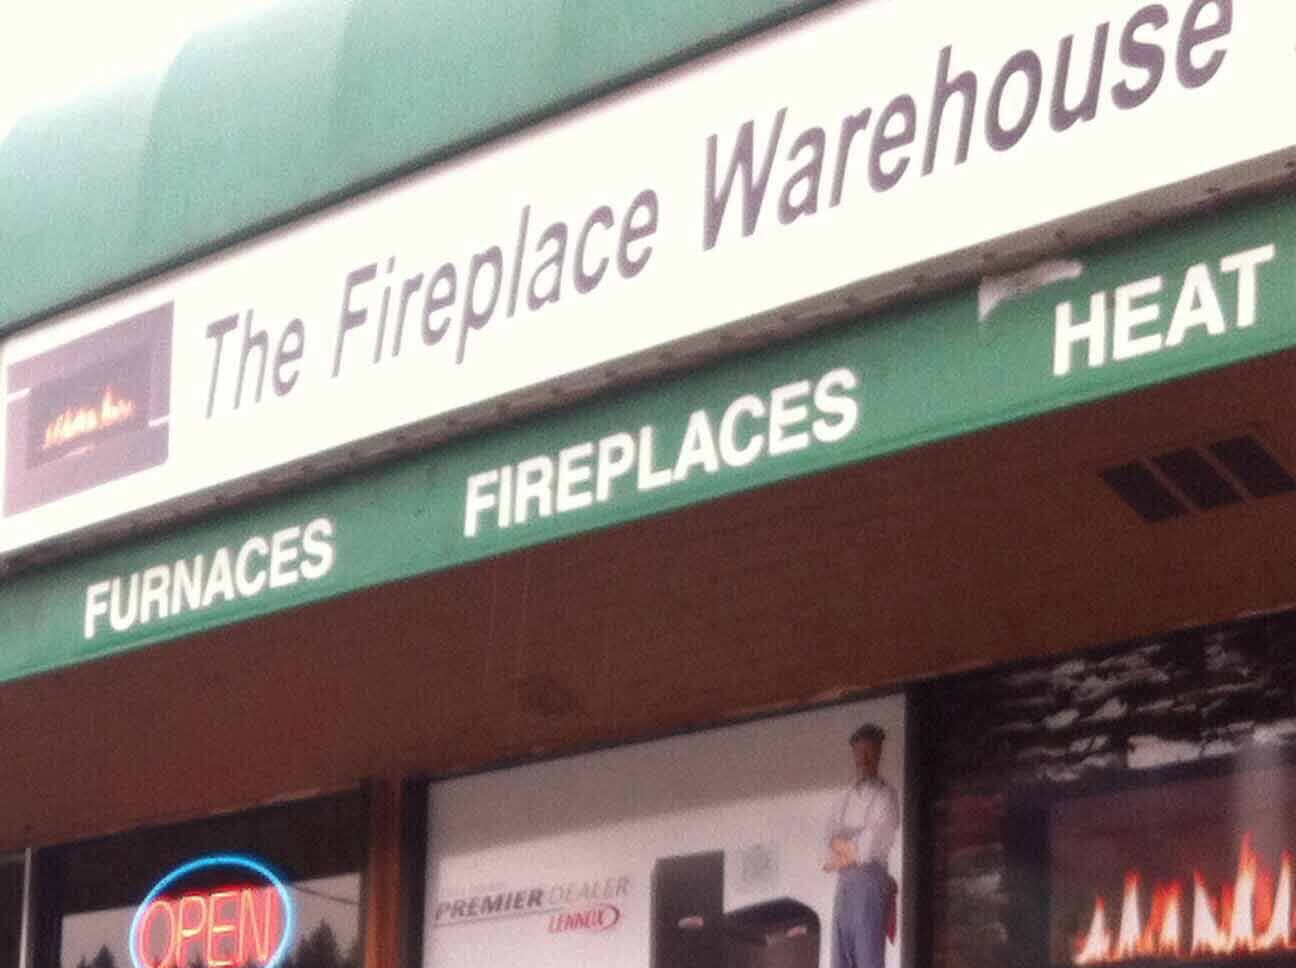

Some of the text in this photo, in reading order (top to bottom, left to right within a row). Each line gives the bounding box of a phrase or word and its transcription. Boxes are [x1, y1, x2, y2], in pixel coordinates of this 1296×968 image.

[204, 0, 1234, 420] The Fireplace Warehouse
[1051, 244, 1276, 376] HEAT
[464, 368, 861, 538] FIREPLACES
[82, 516, 336, 640] FURNACES
[434, 875, 632, 922] PREMIER DEALER
